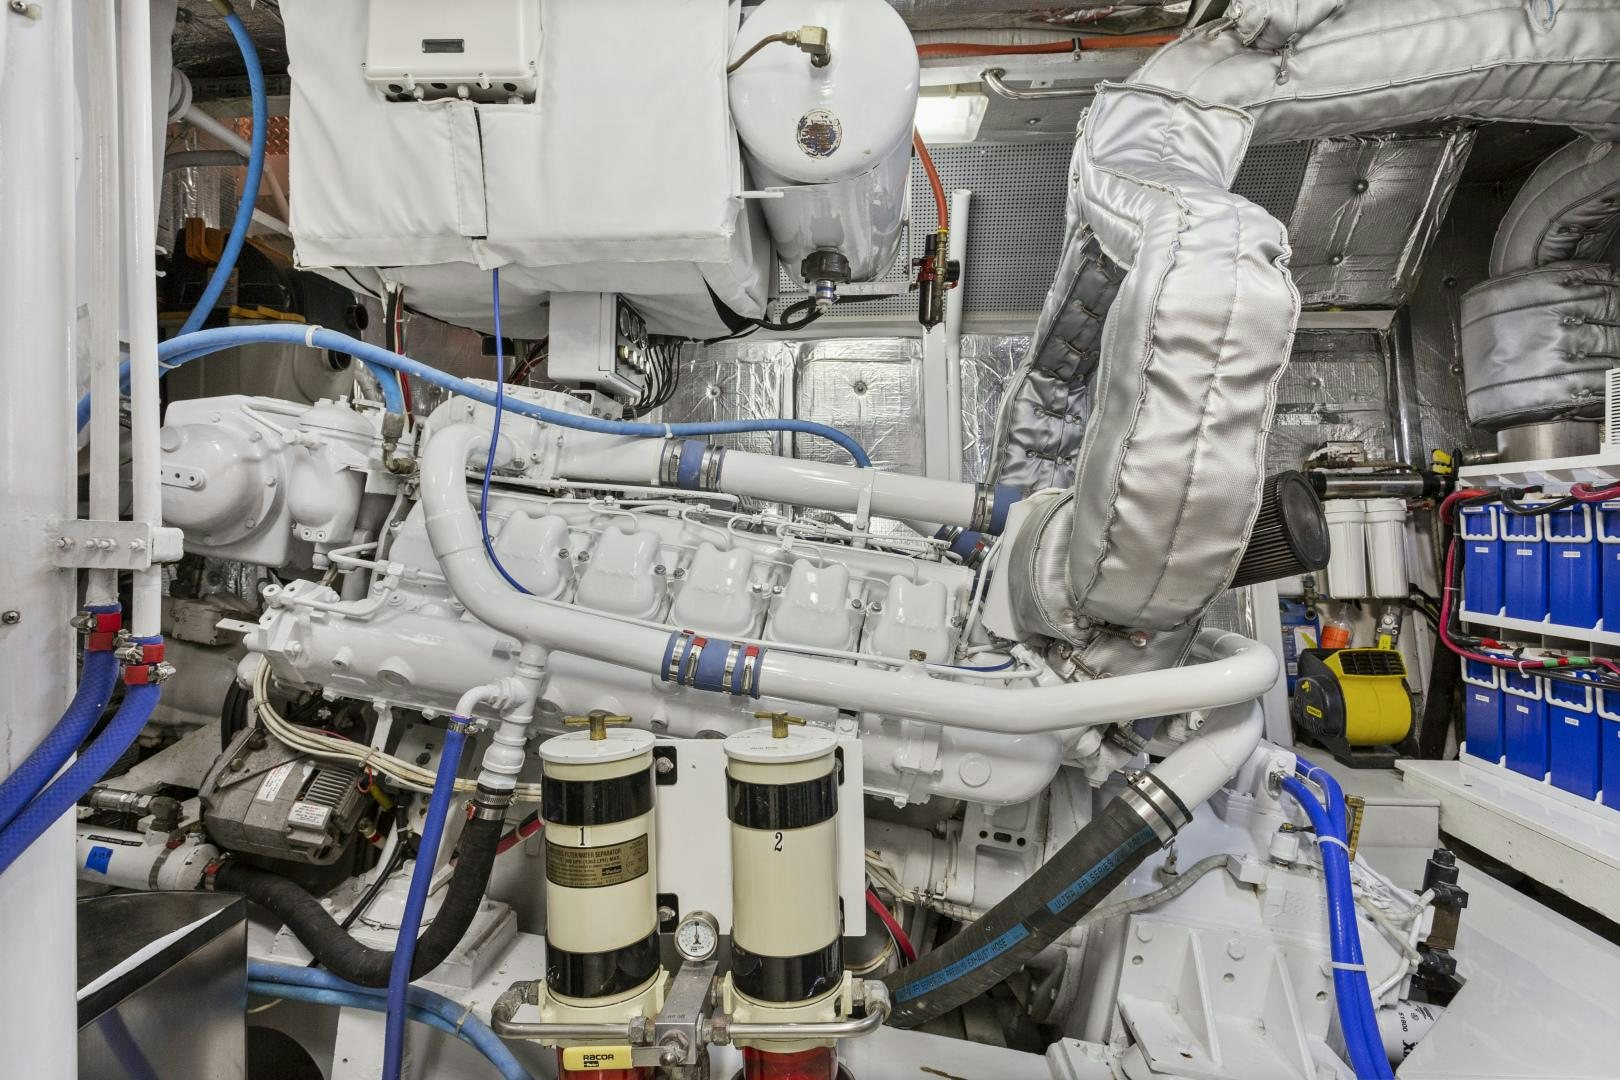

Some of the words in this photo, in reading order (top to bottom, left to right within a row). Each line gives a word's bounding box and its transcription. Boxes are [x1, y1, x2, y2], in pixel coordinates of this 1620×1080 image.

[580, 826, 585, 846] 1
[774, 831, 783, 852] 2
[595, 848, 621, 857] SEPARATOR
